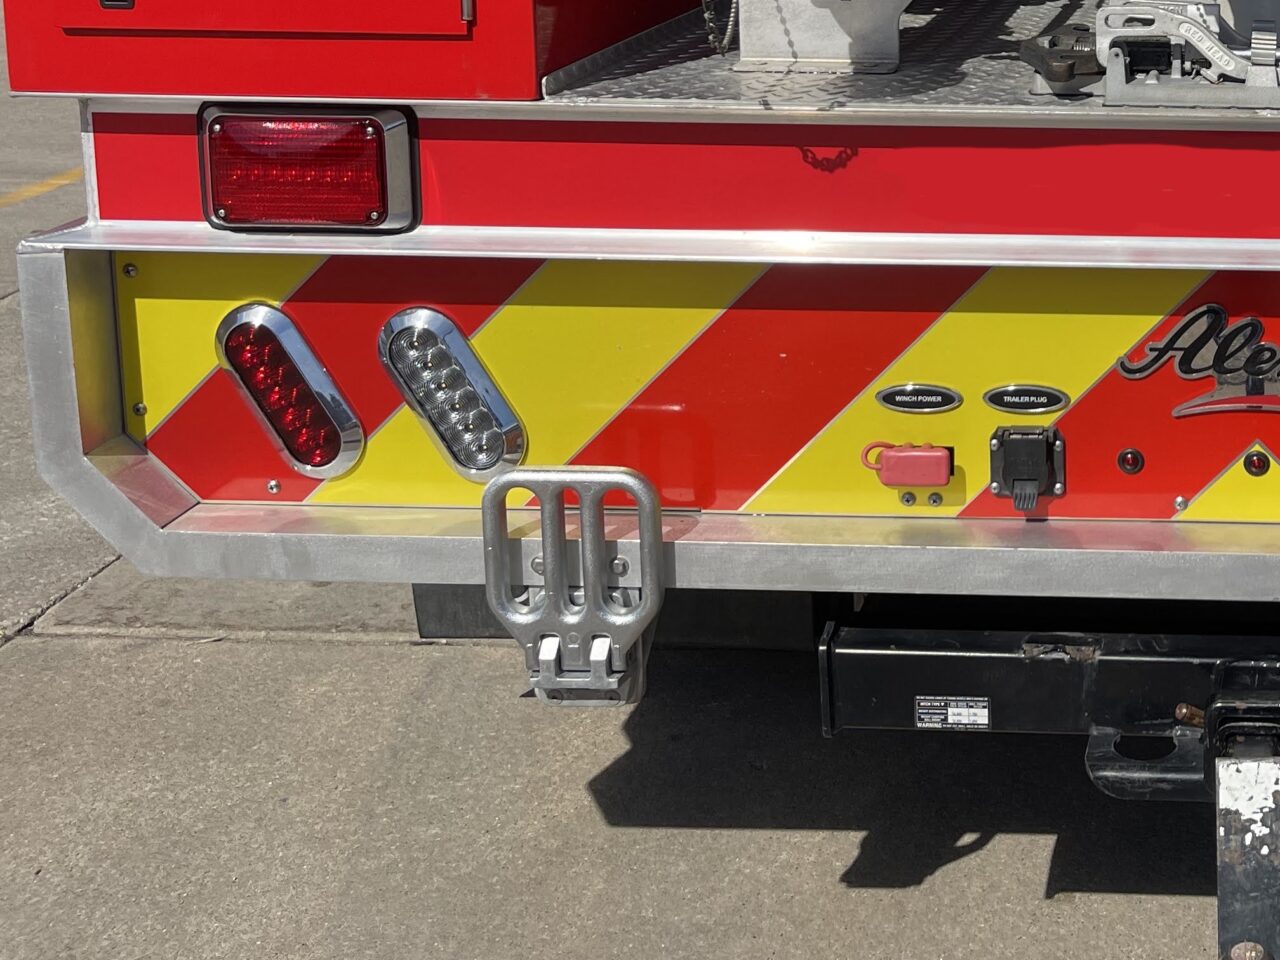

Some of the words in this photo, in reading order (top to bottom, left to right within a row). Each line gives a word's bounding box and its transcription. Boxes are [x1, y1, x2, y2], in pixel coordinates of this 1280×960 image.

[1184, 25, 1203, 42] RED
[1205, 43, 1231, 66] HEAD
[1003, 395, 1030, 403] TRAILER
